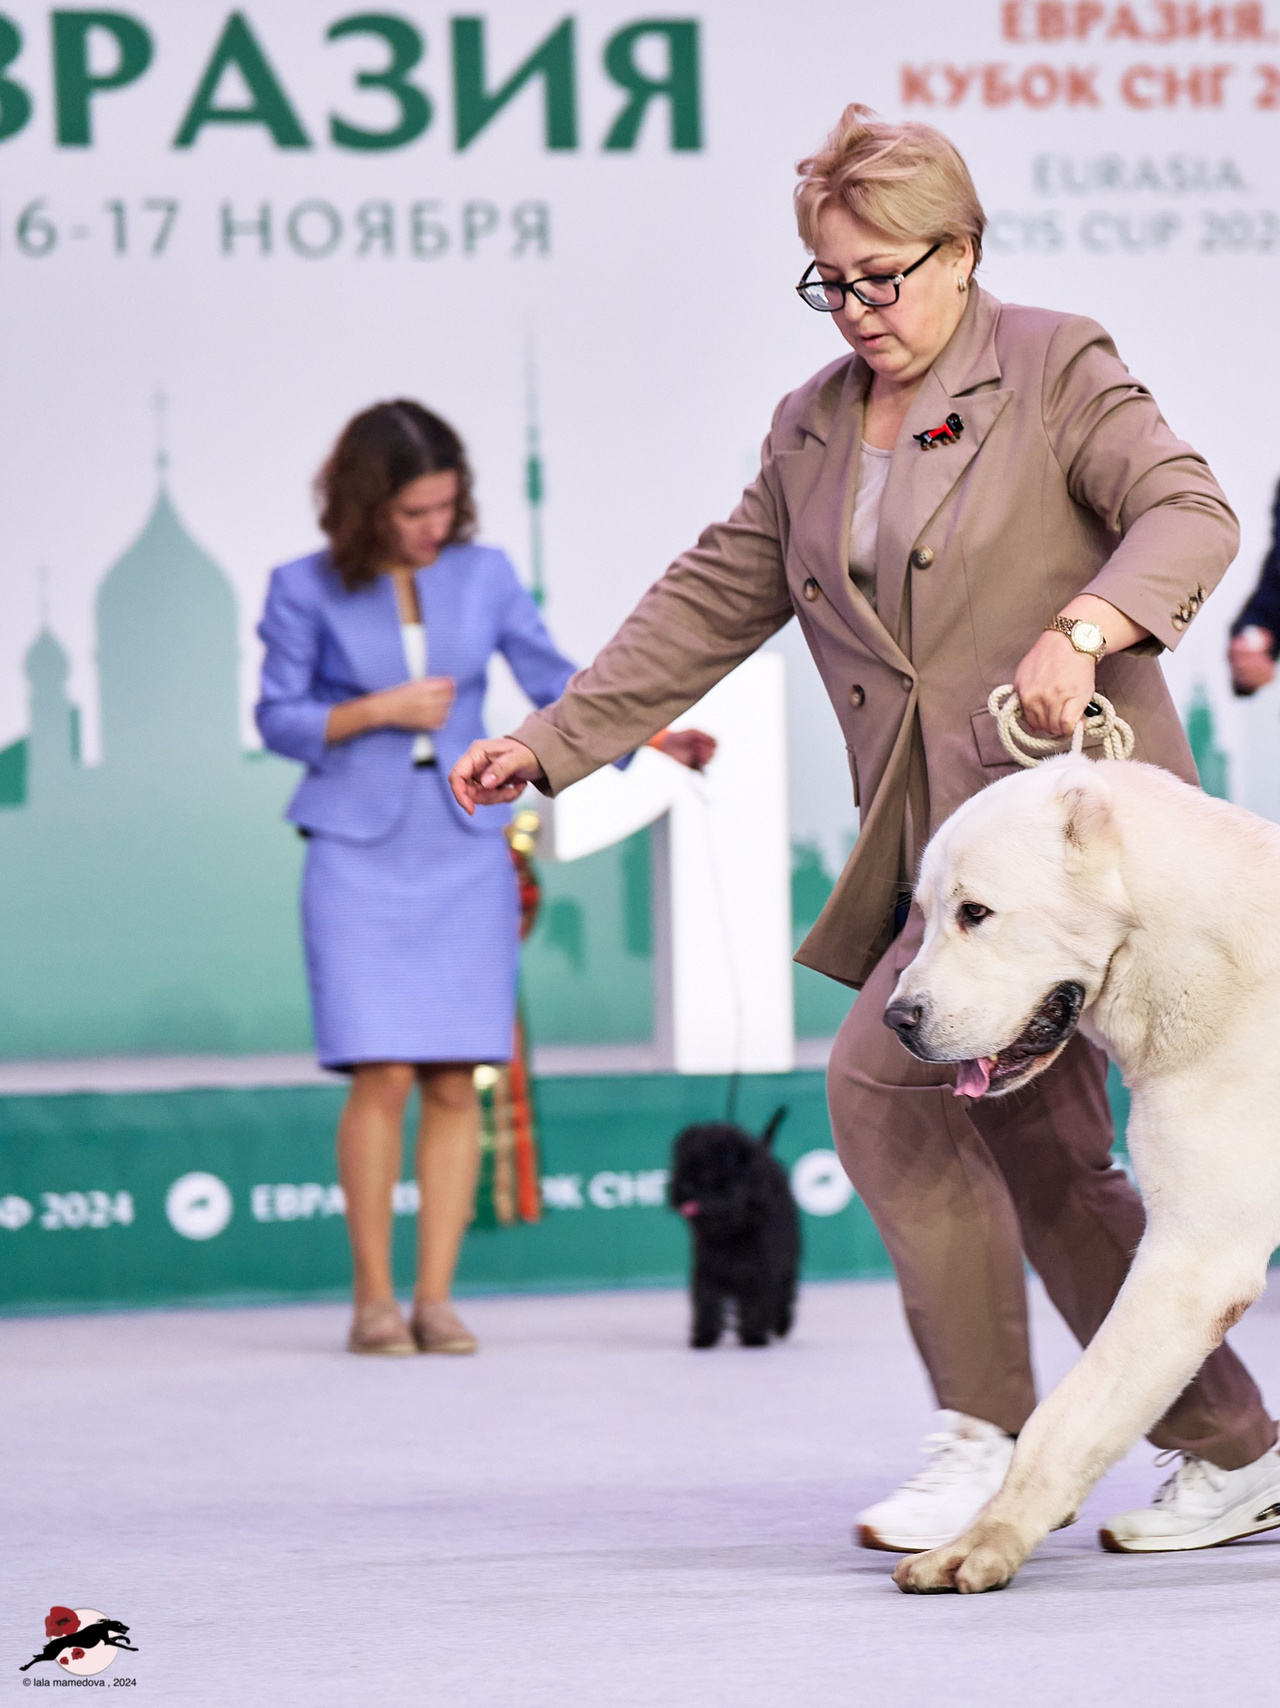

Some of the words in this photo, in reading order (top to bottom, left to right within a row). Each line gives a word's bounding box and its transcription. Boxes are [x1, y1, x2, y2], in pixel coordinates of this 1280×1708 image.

[900, 62, 1102, 110] КУБОК
[1118, 63, 1232, 109] СНГ
[220, 200, 554, 260] НОЯБРЯ
[986, 210, 1064, 254] CIS
[1077, 209, 1182, 254] CUP
